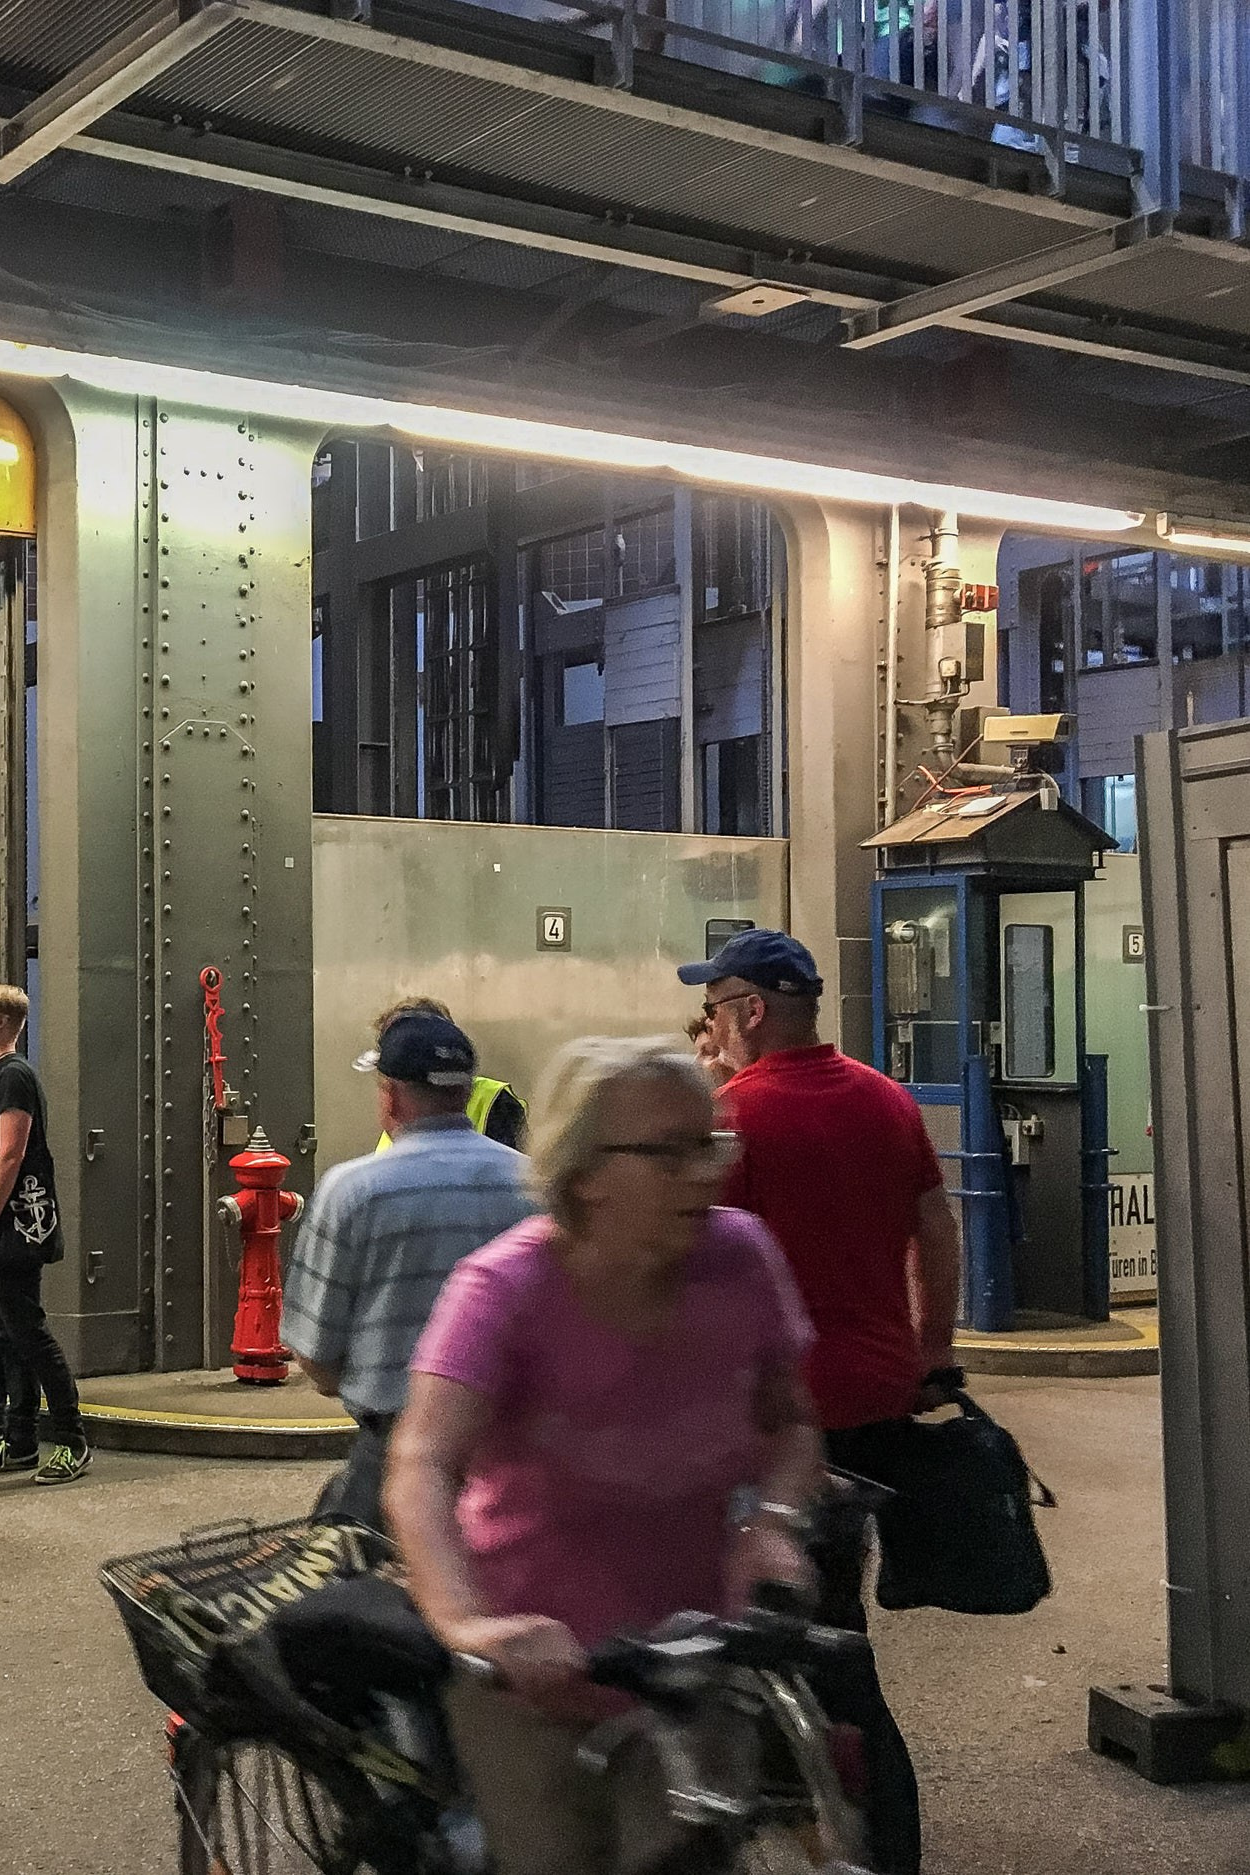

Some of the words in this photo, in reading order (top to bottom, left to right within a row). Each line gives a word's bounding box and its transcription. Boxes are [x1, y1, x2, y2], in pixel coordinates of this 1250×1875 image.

[549, 918, 559, 939] 4
[1132, 935, 1140, 954] 5
[1109, 1184, 1154, 1227] HAL
[1138, 1249, 1147, 1276] in
